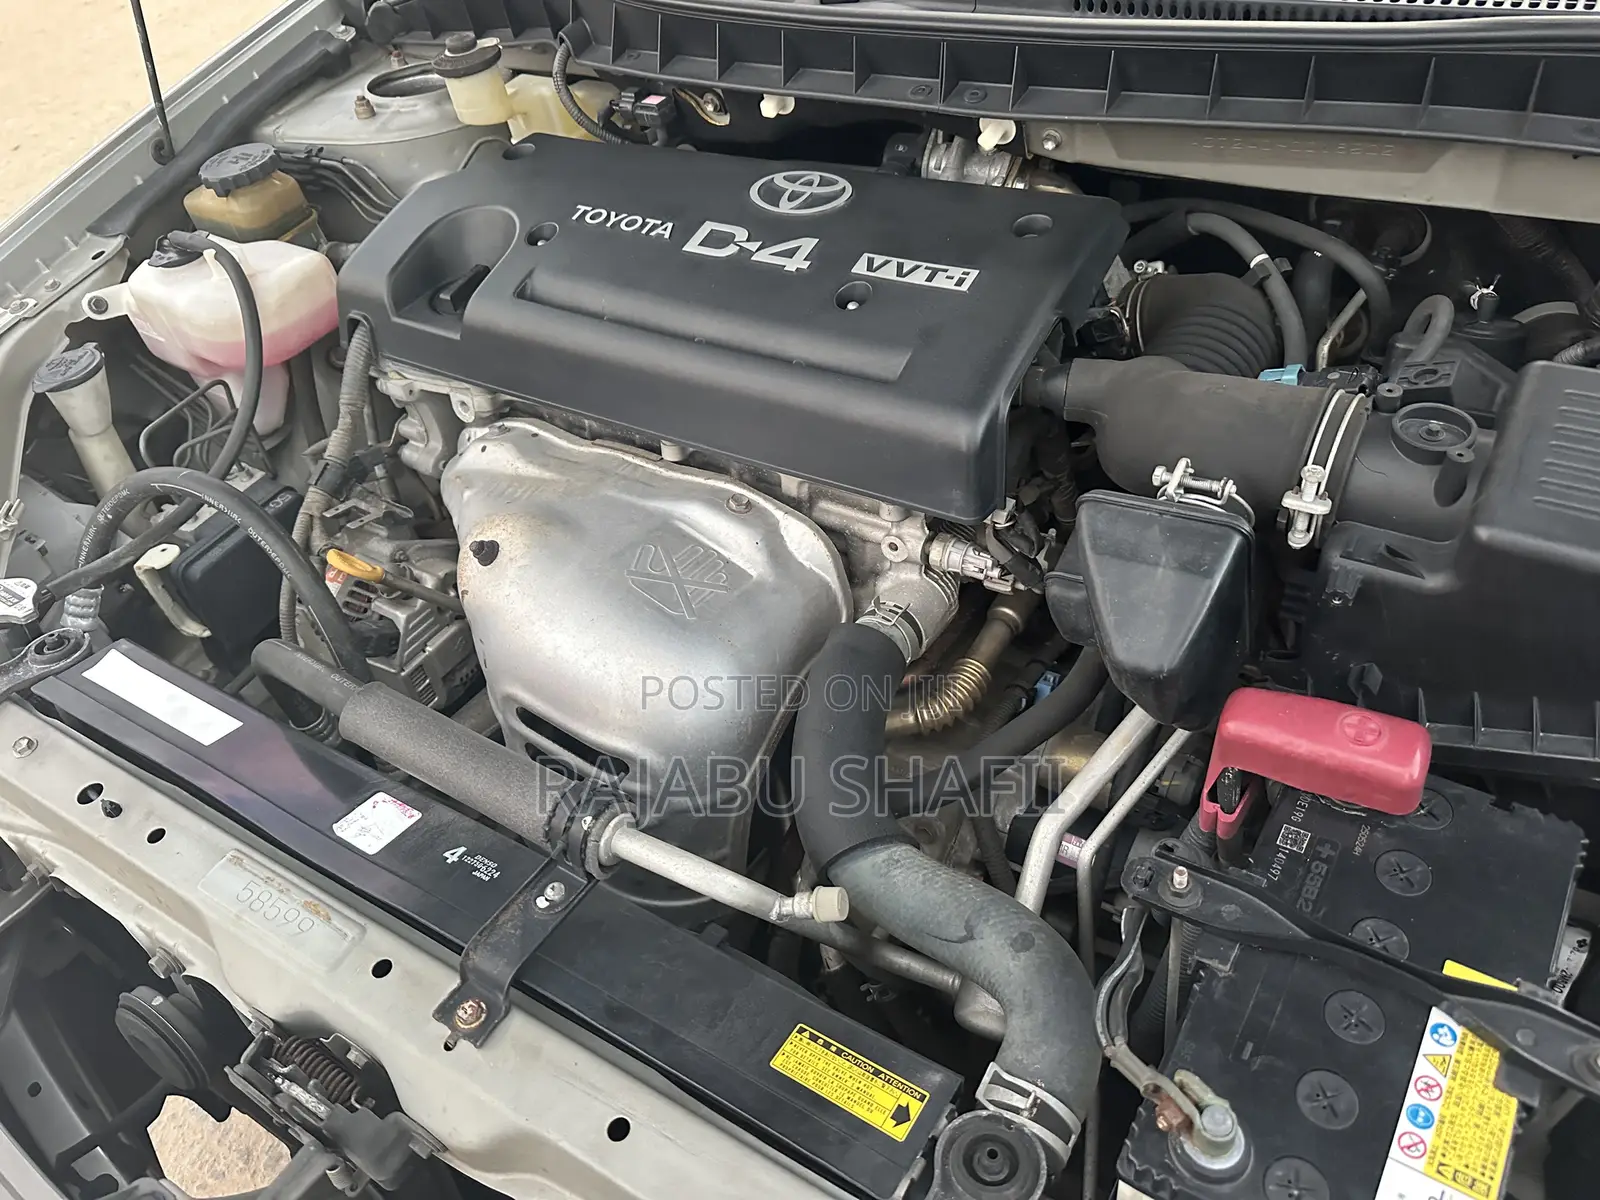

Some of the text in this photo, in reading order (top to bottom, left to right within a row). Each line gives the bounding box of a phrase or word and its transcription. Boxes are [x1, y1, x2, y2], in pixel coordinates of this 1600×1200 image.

[571, 204, 675, 239] TOYOTA
[861, 253, 975, 289] VVT-i
[442, 846, 468, 865] 4
[474, 854, 498, 868] DENSO
[472, 870, 491, 882] JAPAN
[236, 880, 315, 936] 58599
[840, 1051, 874, 1073] CAUTION
[877, 1071, 921, 1100] ATTENTION
